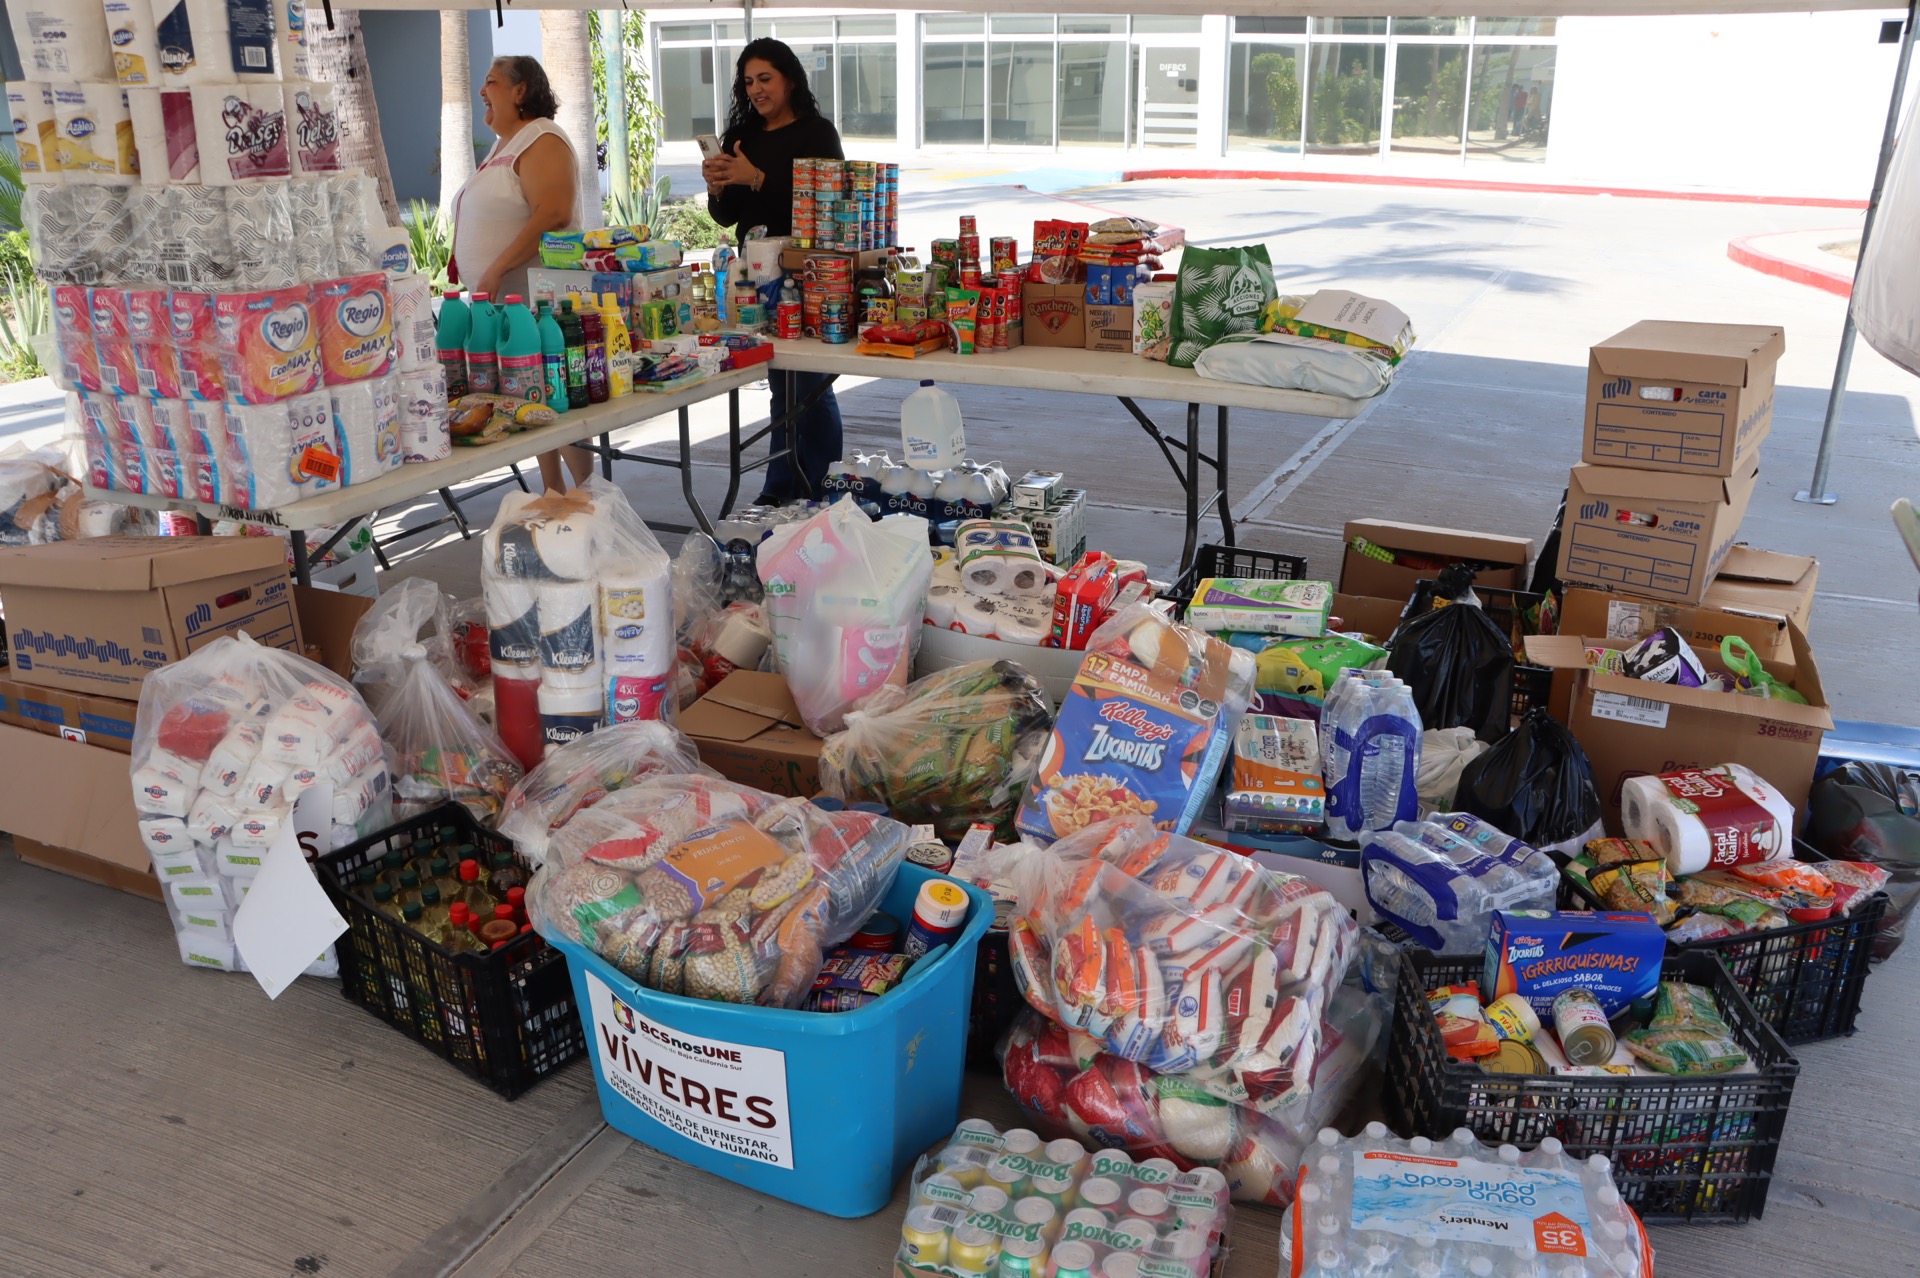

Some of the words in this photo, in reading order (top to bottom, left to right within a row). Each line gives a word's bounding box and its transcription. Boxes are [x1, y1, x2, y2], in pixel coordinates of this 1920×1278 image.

[66, 121, 95, 137] Azálea
[544, 242, 575, 251] Suavelastic
[174, 297, 190, 309] 4XL
[218, 301, 234, 313] 4XL
[248, 302, 271, 310] NUEVO
[1028, 302, 1079, 316] Rancherita
[345, 305, 379, 325] Regio
[270, 317, 304, 340] Regio
[343, 335, 387, 362] EcoMAX
[270, 351, 312, 379] EcoMAX
[612, 357, 632, 368] Downy
[1698, 389, 1727, 400] carta
[1641, 409, 1677, 417] CONTENIDO
[1672, 519, 1700, 531] carta
[1617, 532, 1651, 543] CONTENIDO
[264, 582, 287, 596] carta
[764, 581, 797, 594] draui
[225, 616, 256, 631] CONTENIDO
[1078, 603, 1089, 635] Absorsec
[1695, 631, 1714, 642] 230
[142, 649, 168, 662] carta
[500, 645, 538, 659] Kleenex
[551, 651, 593, 666] Kleenex
[1088, 656, 1108, 675] 17
[1111, 661, 1148, 683] EMPA
[619, 685, 638, 695] 4XL
[614, 702, 637, 713] Regio
[1100, 701, 1174, 740] Kellogg's
[1757, 723, 1777, 737] 38
[1778, 726, 1812, 738] PAÑALES
[1084, 724, 1166, 771] ZUCARITAS
[1255, 780, 1263, 788] 40
[1452, 820, 1466, 831] 6
[691, 842, 721, 860] FRIJOL
[721, 834, 746, 850] PINTO
[1714, 832, 1727, 863] Facial
[1723, 826, 1741, 866] Quality
[188, 952, 224, 967] MASECA
[1507, 945, 1545, 964] ZUCARITAS
[1521, 949, 1640, 982] ¡GRRRIQUÍSIMAS!
[1533, 982, 1541, 990] EL
[1541, 976, 1573, 987] DELICIOSO
[1573, 972, 1604, 984] SABOR
[1594, 983, 1622, 992] CONOCES
[1500, 1015, 1516, 1036] REAL
[639, 1019, 742, 1063] BCSnosUNE
[641, 1032, 667, 1051] Gobierno
[667, 1046, 676, 1055] de
[677, 1050, 692, 1062] Baja
[693, 1055, 728, 1069] California
[729, 1064, 742, 1072] Sur
[601, 1022, 776, 1129] VÍVERES
[611, 1070, 682, 1124] SUBSECRETARÍA
[685, 1118, 699, 1131] DE
[702, 1125, 772, 1152] BIENESTAR,
[609, 1077, 667, 1123] DESARROLLO
[668, 1118, 706, 1144] SOCIAL
[708, 1136, 716, 1146] Y
[719, 1140, 779, 1163] HUMANO
[962, 1132, 996, 1146] MANGO
[998, 1151, 1073, 1182] BOING!
[1412, 1157, 1452, 1166] Contenido
[1092, 1156, 1171, 1185] BOING!
[1403, 1172, 1536, 1196] purificada
[930, 1187, 964, 1202] MANGO
[1468, 1189, 1537, 1206] agua
[965, 1211, 1046, 1243] BOING!
[1438, 1214, 1509, 1231] Member's
[1064, 1220, 1145, 1250] BOING!
[1541, 1230, 1577, 1246] 35
[1543, 1243, 1578, 1252] Contenido
